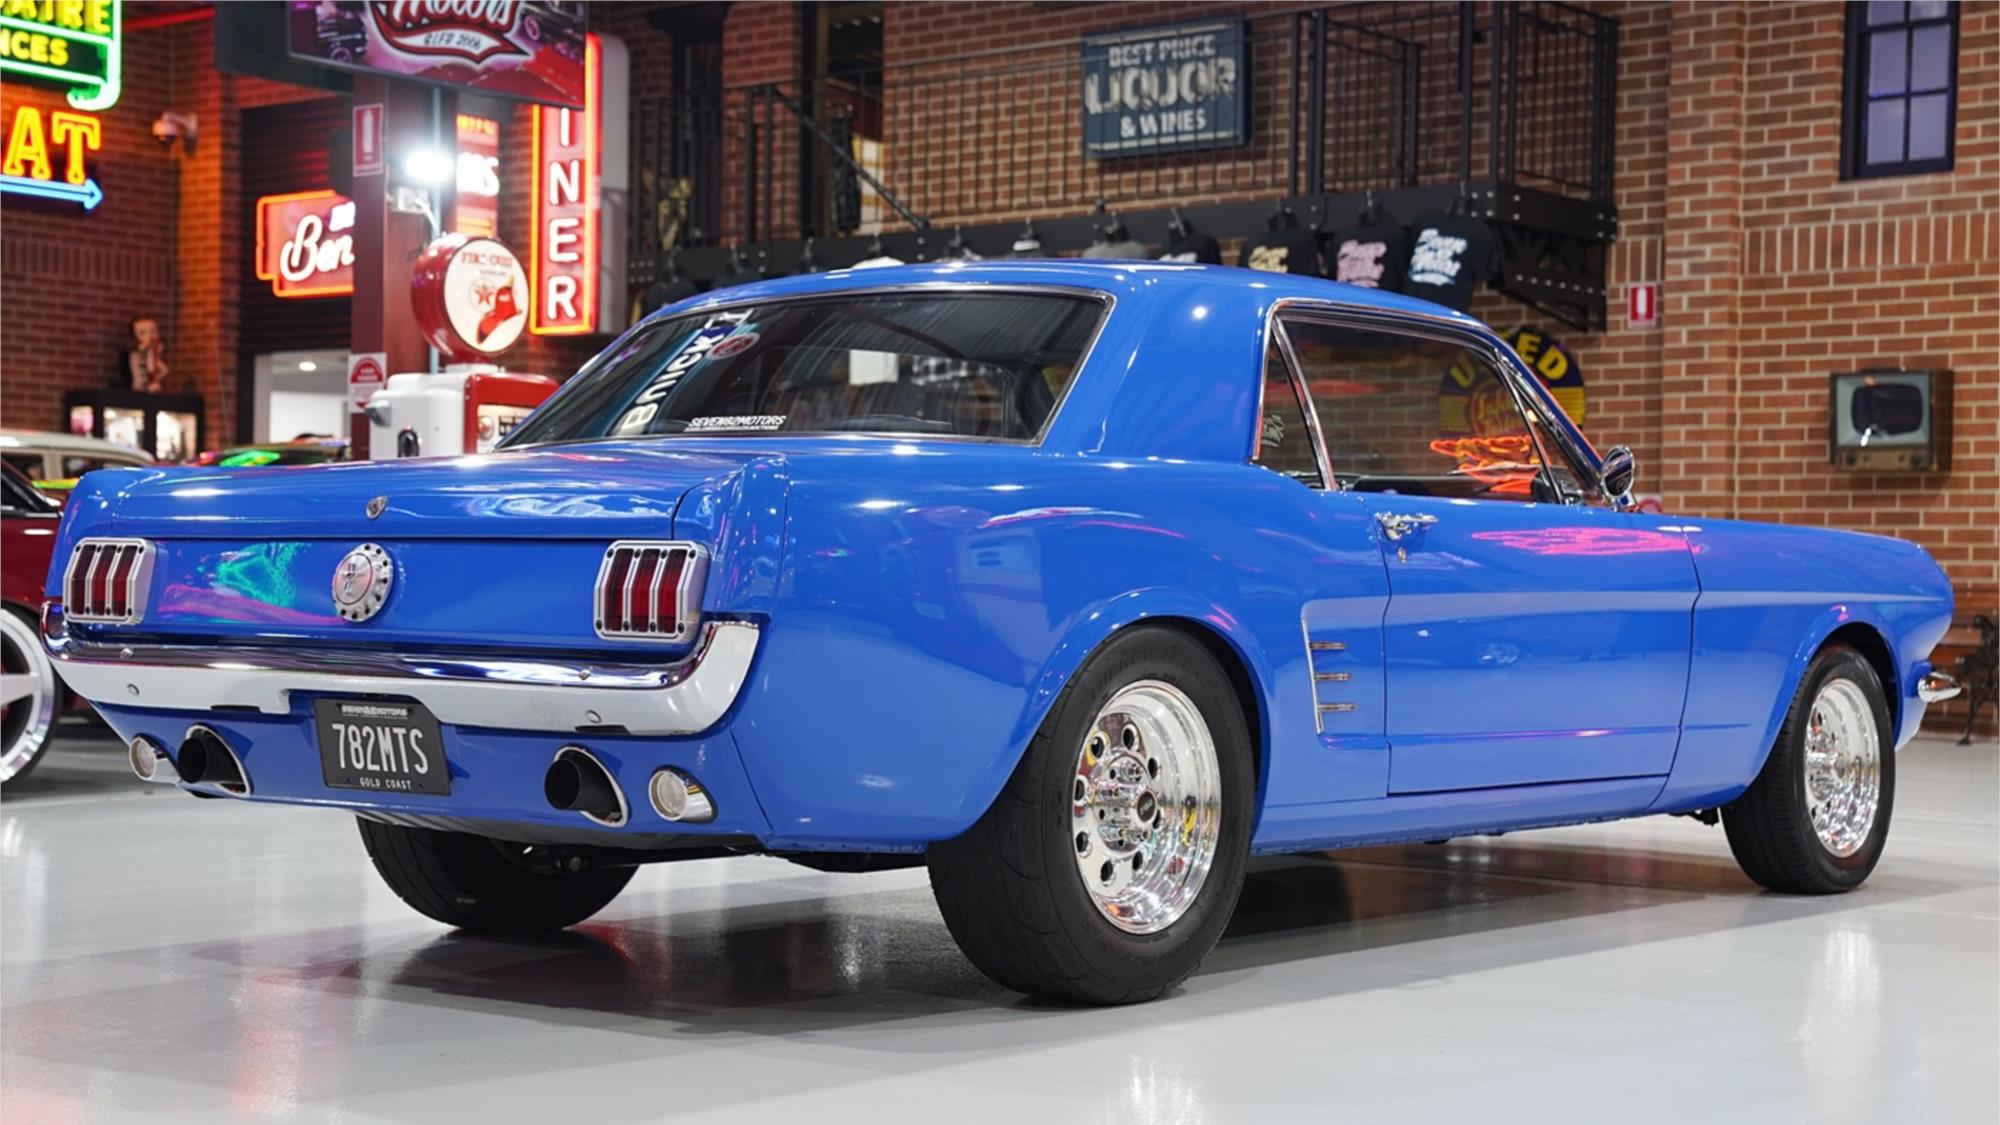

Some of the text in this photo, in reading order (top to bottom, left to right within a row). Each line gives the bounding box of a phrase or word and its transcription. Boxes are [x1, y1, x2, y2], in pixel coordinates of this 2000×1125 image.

[1108, 34, 1216, 68] BEST PRICE
[1120, 108, 1207, 138] & WINES
[547, 105, 581, 321] INER
[331, 722, 429, 775] 782MTS
[359, 776, 412, 791] GOLD COAST
